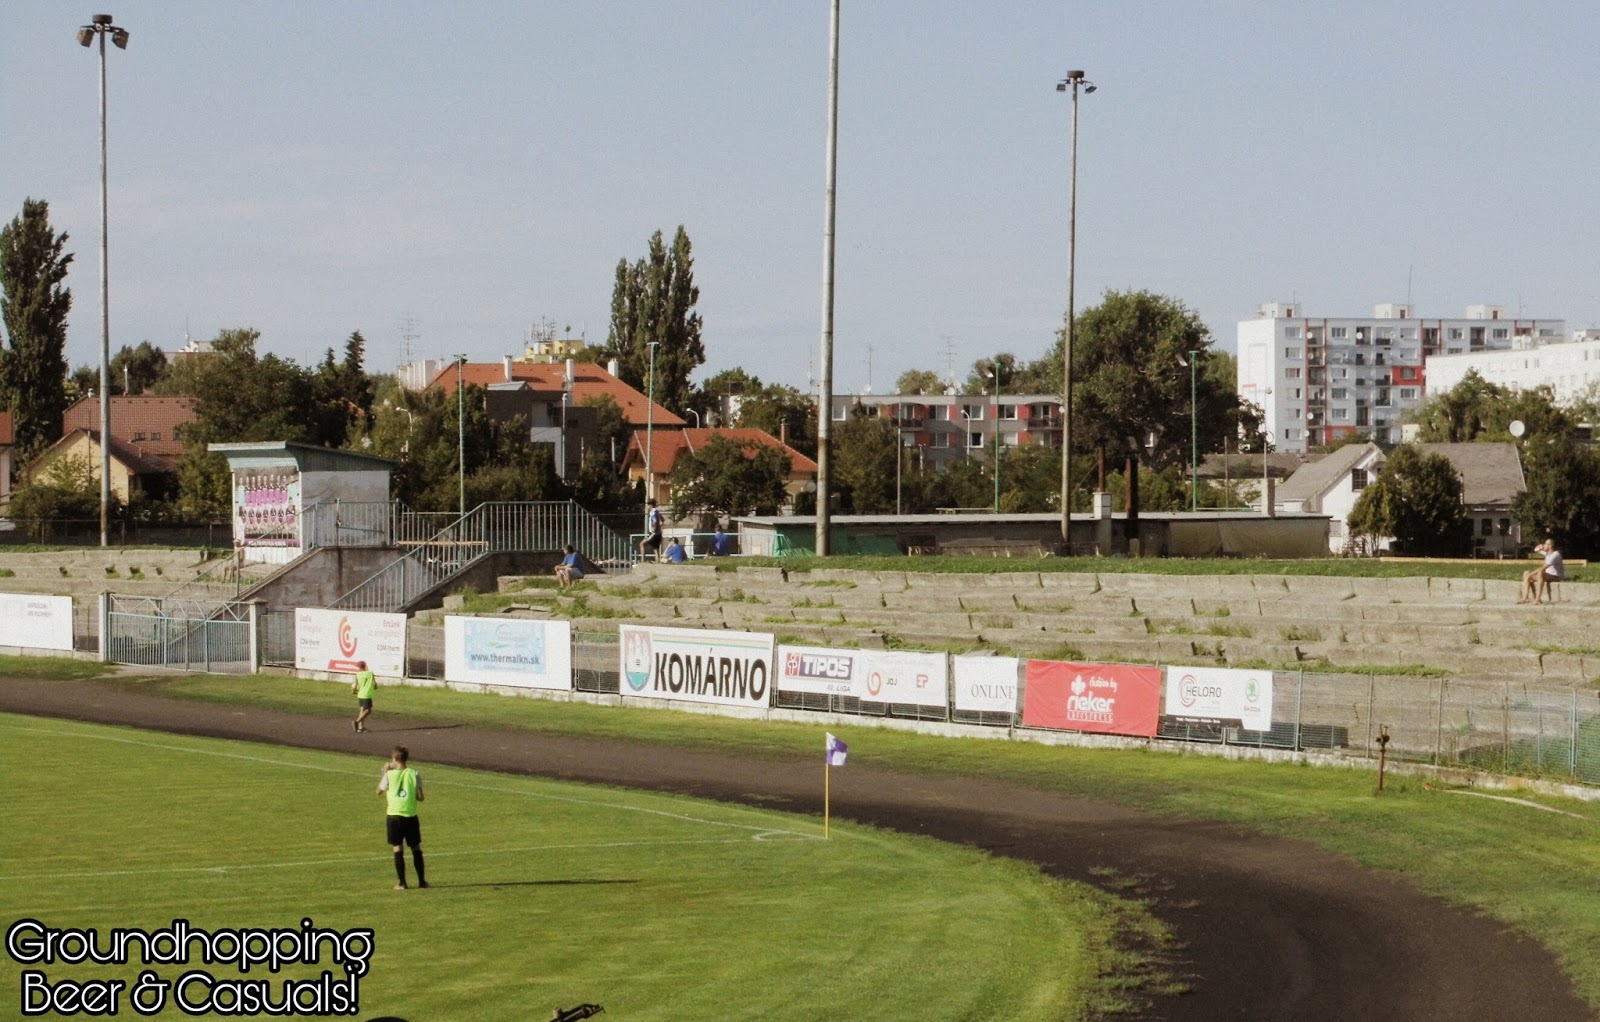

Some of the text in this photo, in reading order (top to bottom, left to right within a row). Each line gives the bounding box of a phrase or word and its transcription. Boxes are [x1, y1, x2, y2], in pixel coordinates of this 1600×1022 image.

[471, 652, 540, 665] www.thermalkn.sk
[654, 647, 767, 701] KOMÁRNO
[803, 656, 850, 678] TIPOS
[836, 685, 851, 693] LIGA
[886, 677, 898, 686] JOJ
[1110, 677, 1118, 693] by
[971, 683, 1015, 700] ONLINE
[1186, 686, 1222, 698] HELORO
[1066, 691, 1115, 713] rieker
[397, 781, 407, 798] 6
